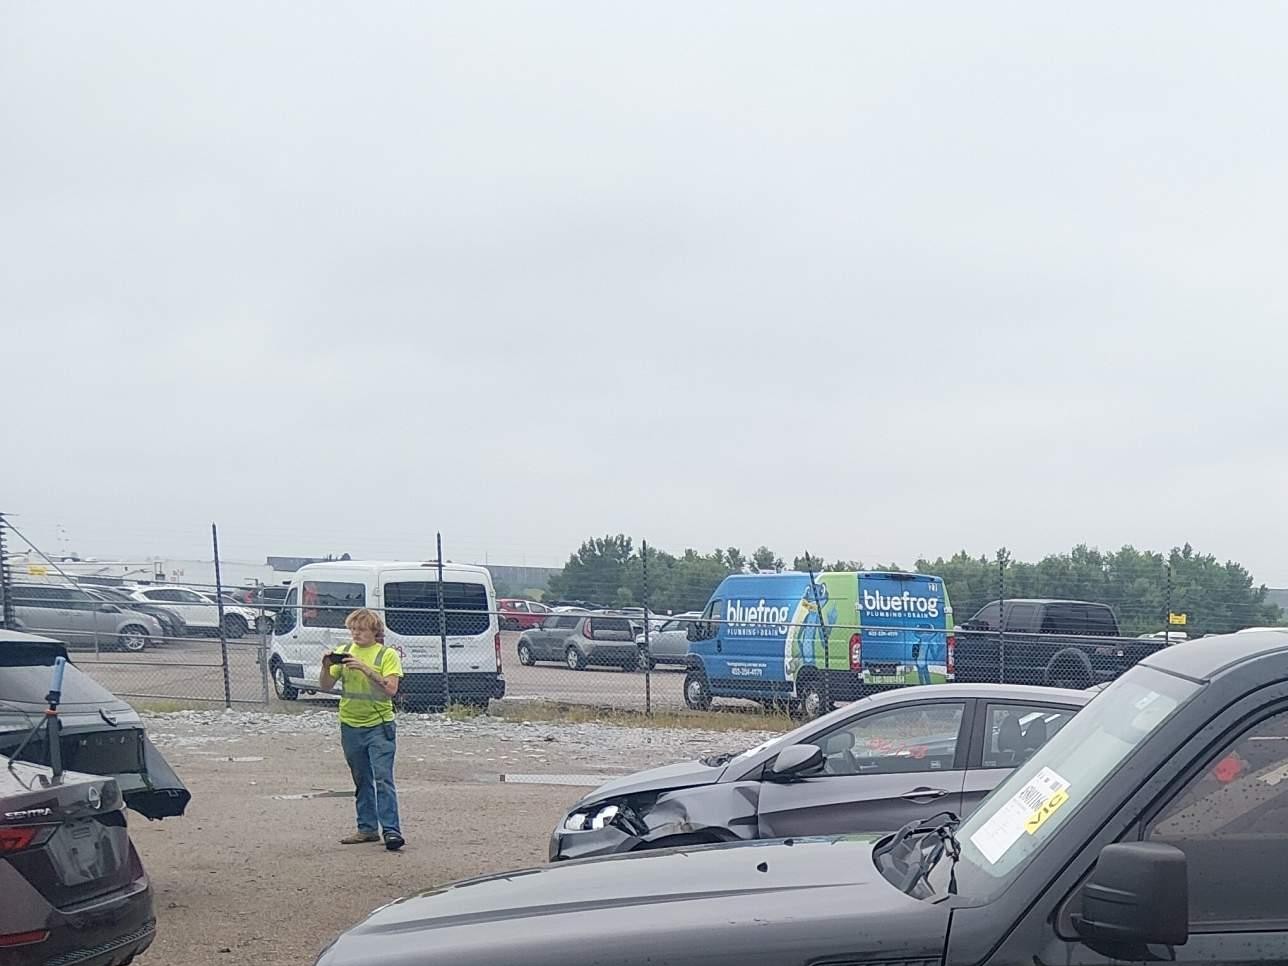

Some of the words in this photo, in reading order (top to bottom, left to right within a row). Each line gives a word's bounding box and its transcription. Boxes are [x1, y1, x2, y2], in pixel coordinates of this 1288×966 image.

[727, 599, 789, 635] bluefrog
[863, 589, 939, 618] bluefrog
[4, 807, 54, 821] SENTRA
